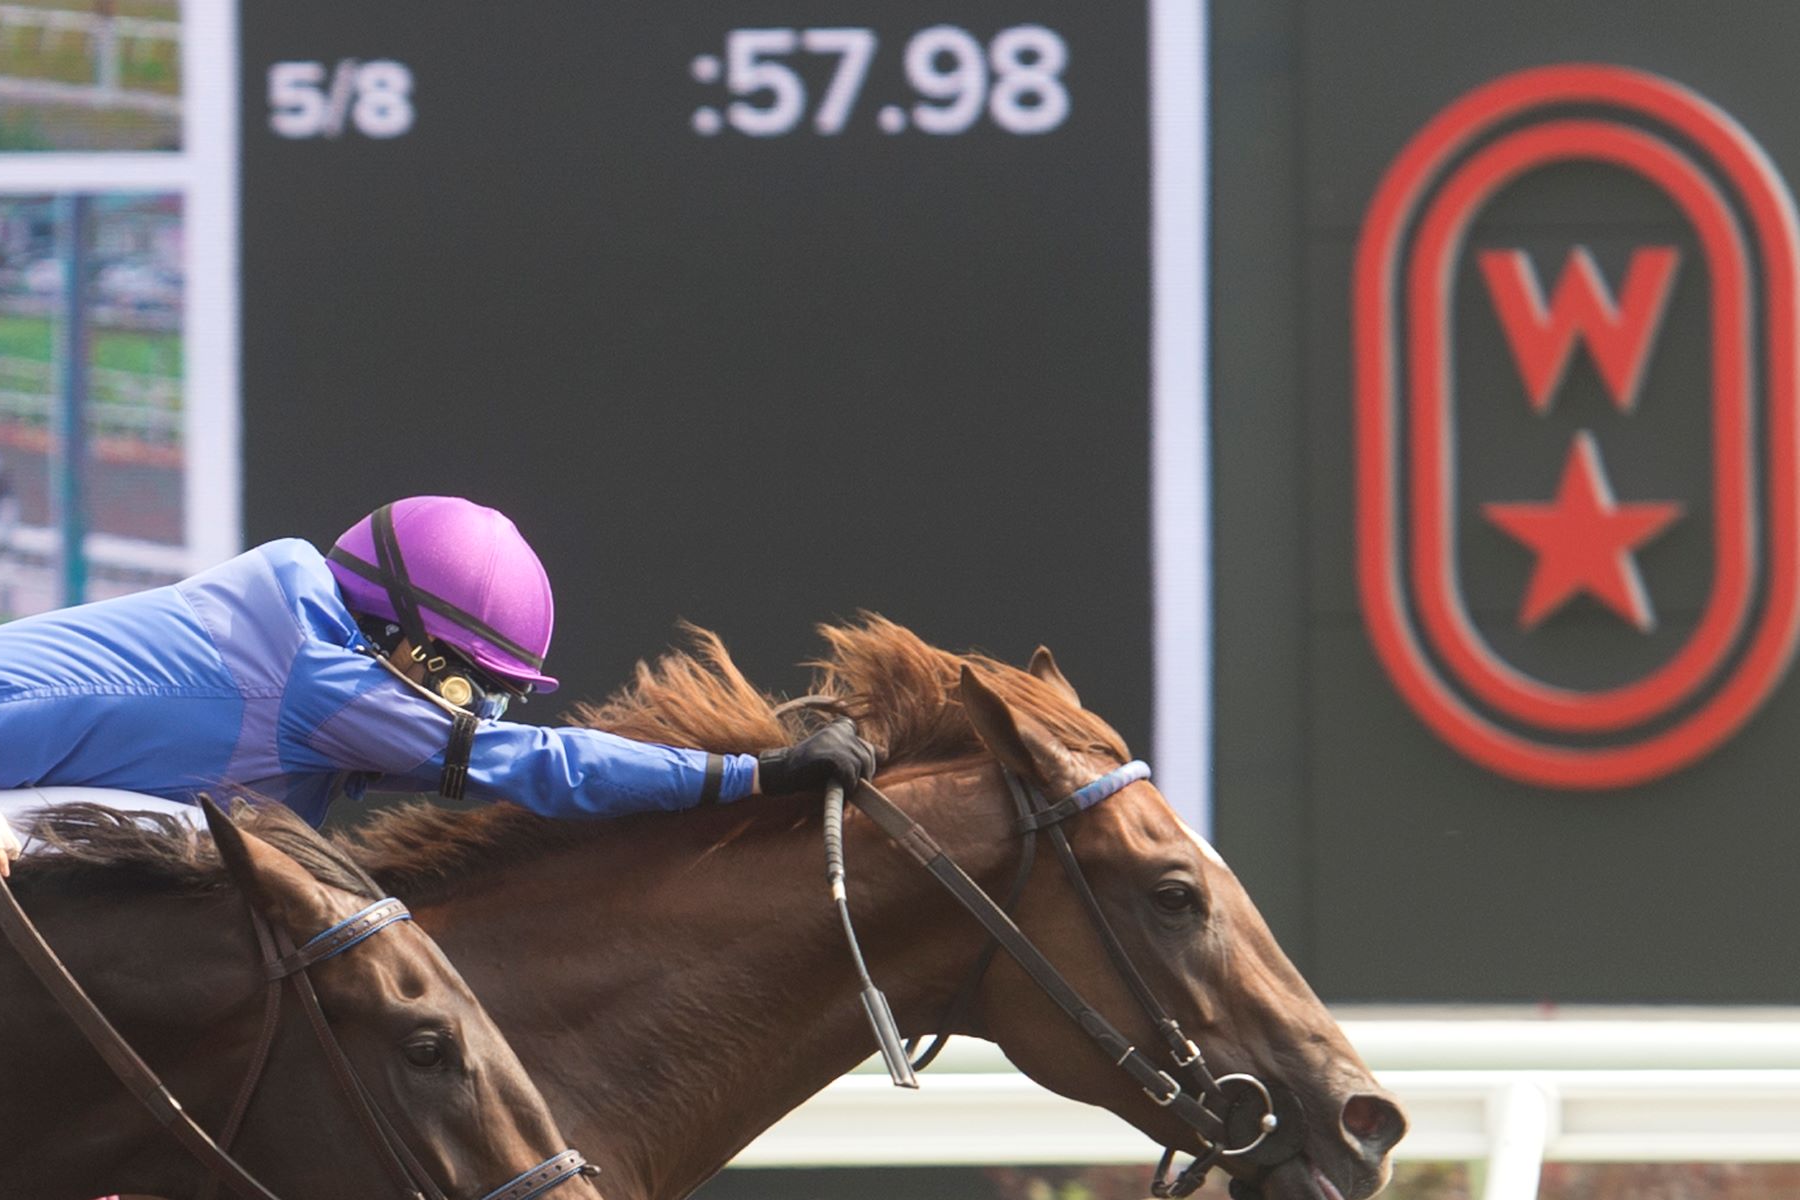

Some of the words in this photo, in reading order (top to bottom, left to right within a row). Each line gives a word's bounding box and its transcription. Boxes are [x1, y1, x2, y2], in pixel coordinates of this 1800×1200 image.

[269, 60, 414, 138] 5/8
[693, 25, 1070, 136] :57.98
[1477, 245, 1680, 411] W
